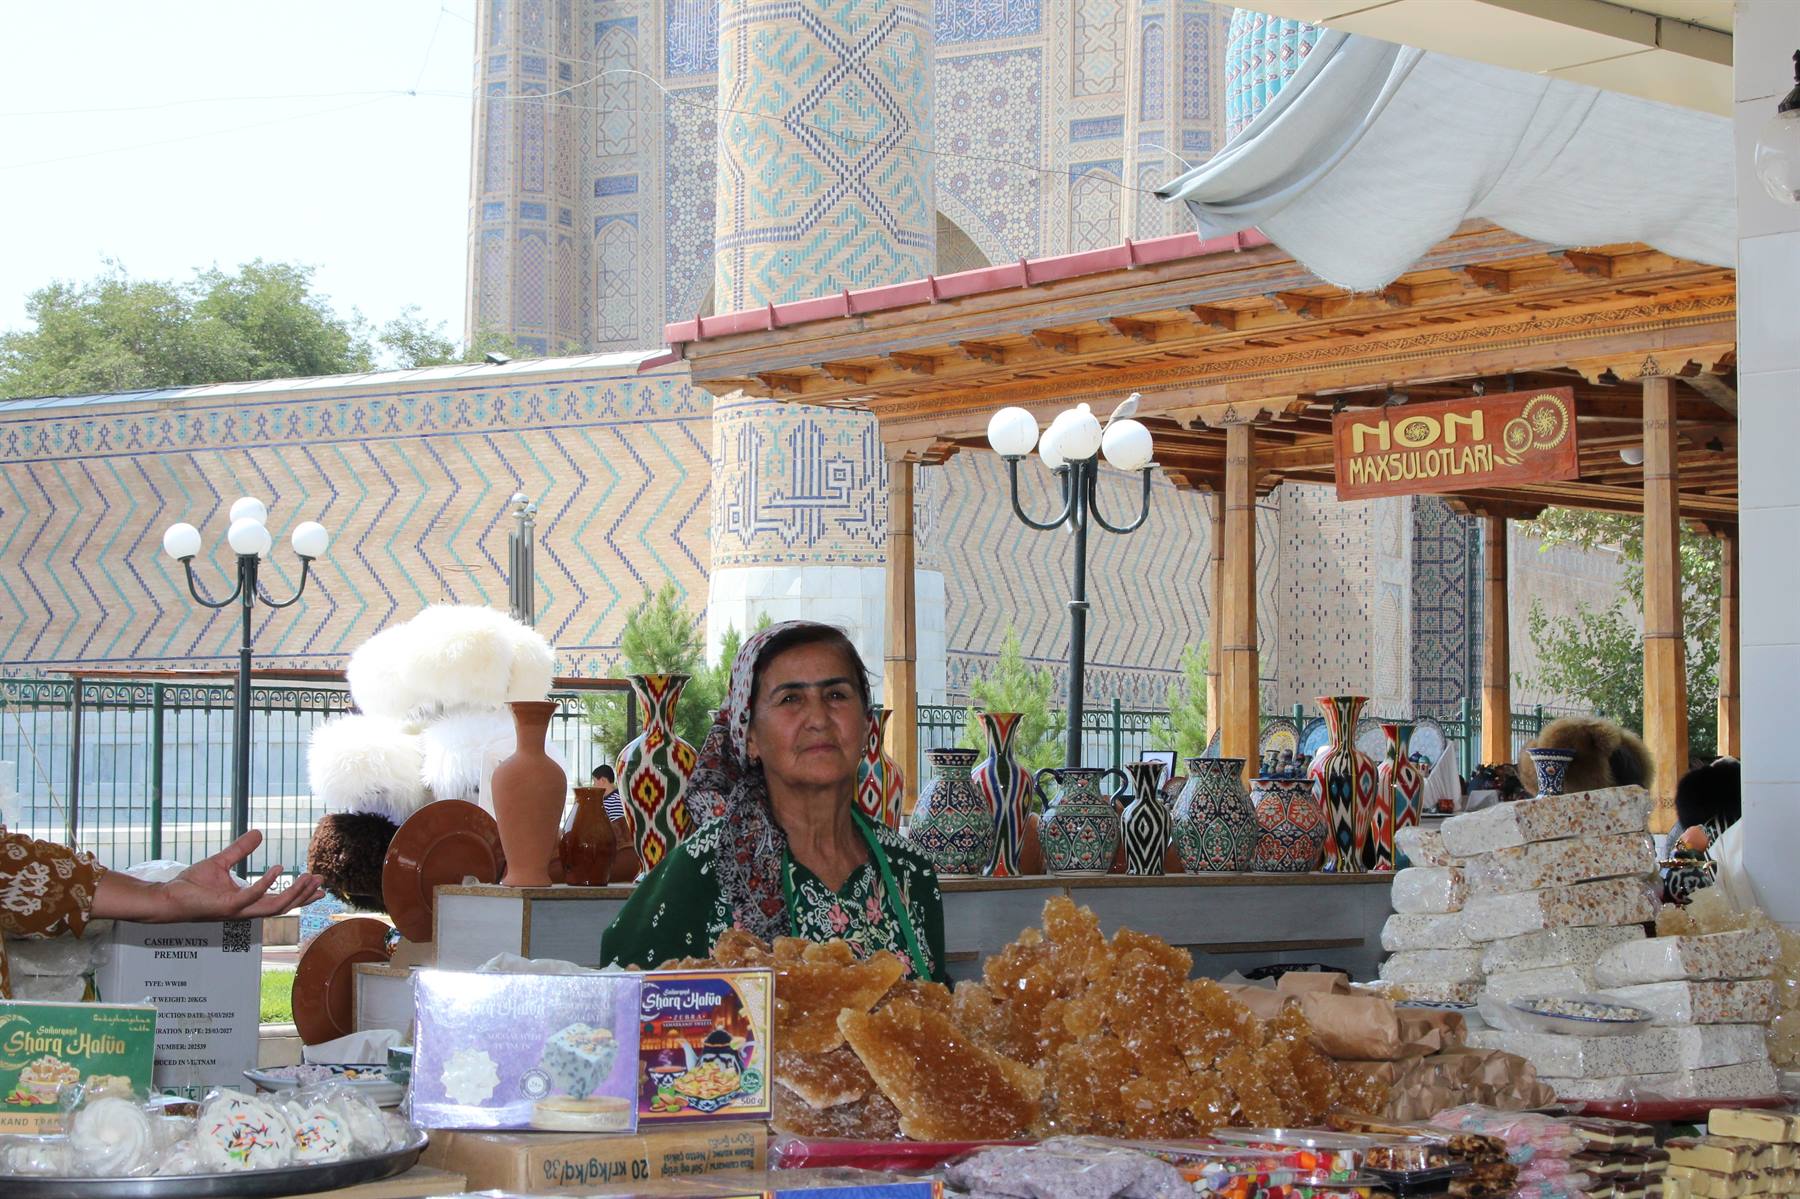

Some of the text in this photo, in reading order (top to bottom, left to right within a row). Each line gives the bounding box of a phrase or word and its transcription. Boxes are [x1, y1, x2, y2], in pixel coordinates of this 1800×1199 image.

[1352, 409, 1484, 453] NON
[1349, 444, 1494, 485] MAXSULOTLARI
[144, 937, 209, 947] CASHEW NUTS
[154, 950, 198, 959] PREMIUM
[642, 993, 681, 1011] Sharq
[3, 1030, 63, 1058] Sharq
[631, 1159, 649, 1180] 20
